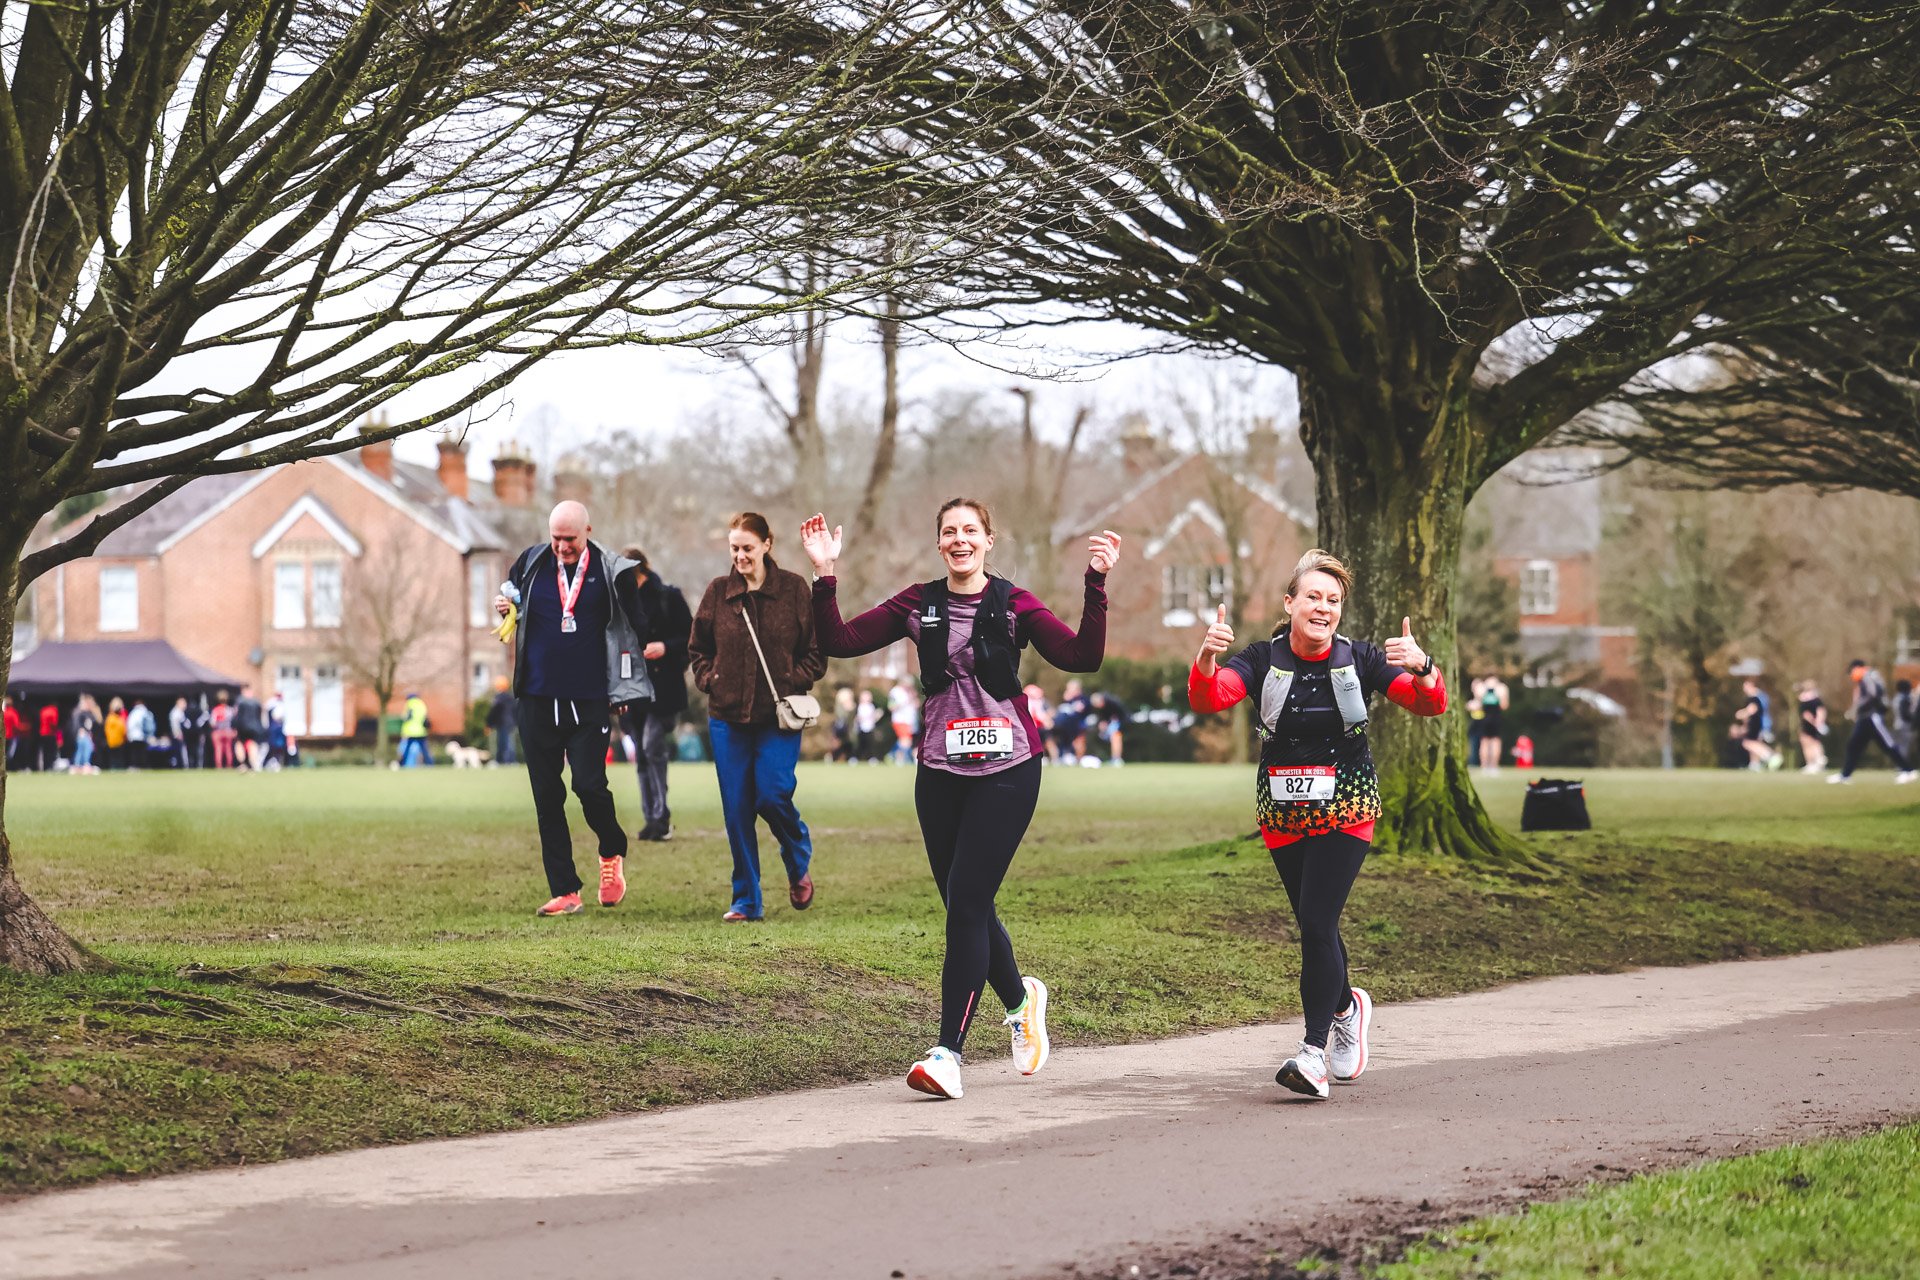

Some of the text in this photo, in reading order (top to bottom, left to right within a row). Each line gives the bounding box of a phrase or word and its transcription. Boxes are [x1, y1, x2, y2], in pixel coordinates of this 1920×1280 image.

[953, 720, 979, 728] WINCHESTER
[958, 729, 997, 746] 1265
[1275, 768, 1302, 776] WINCHESTER
[1285, 777, 1315, 793] 827
